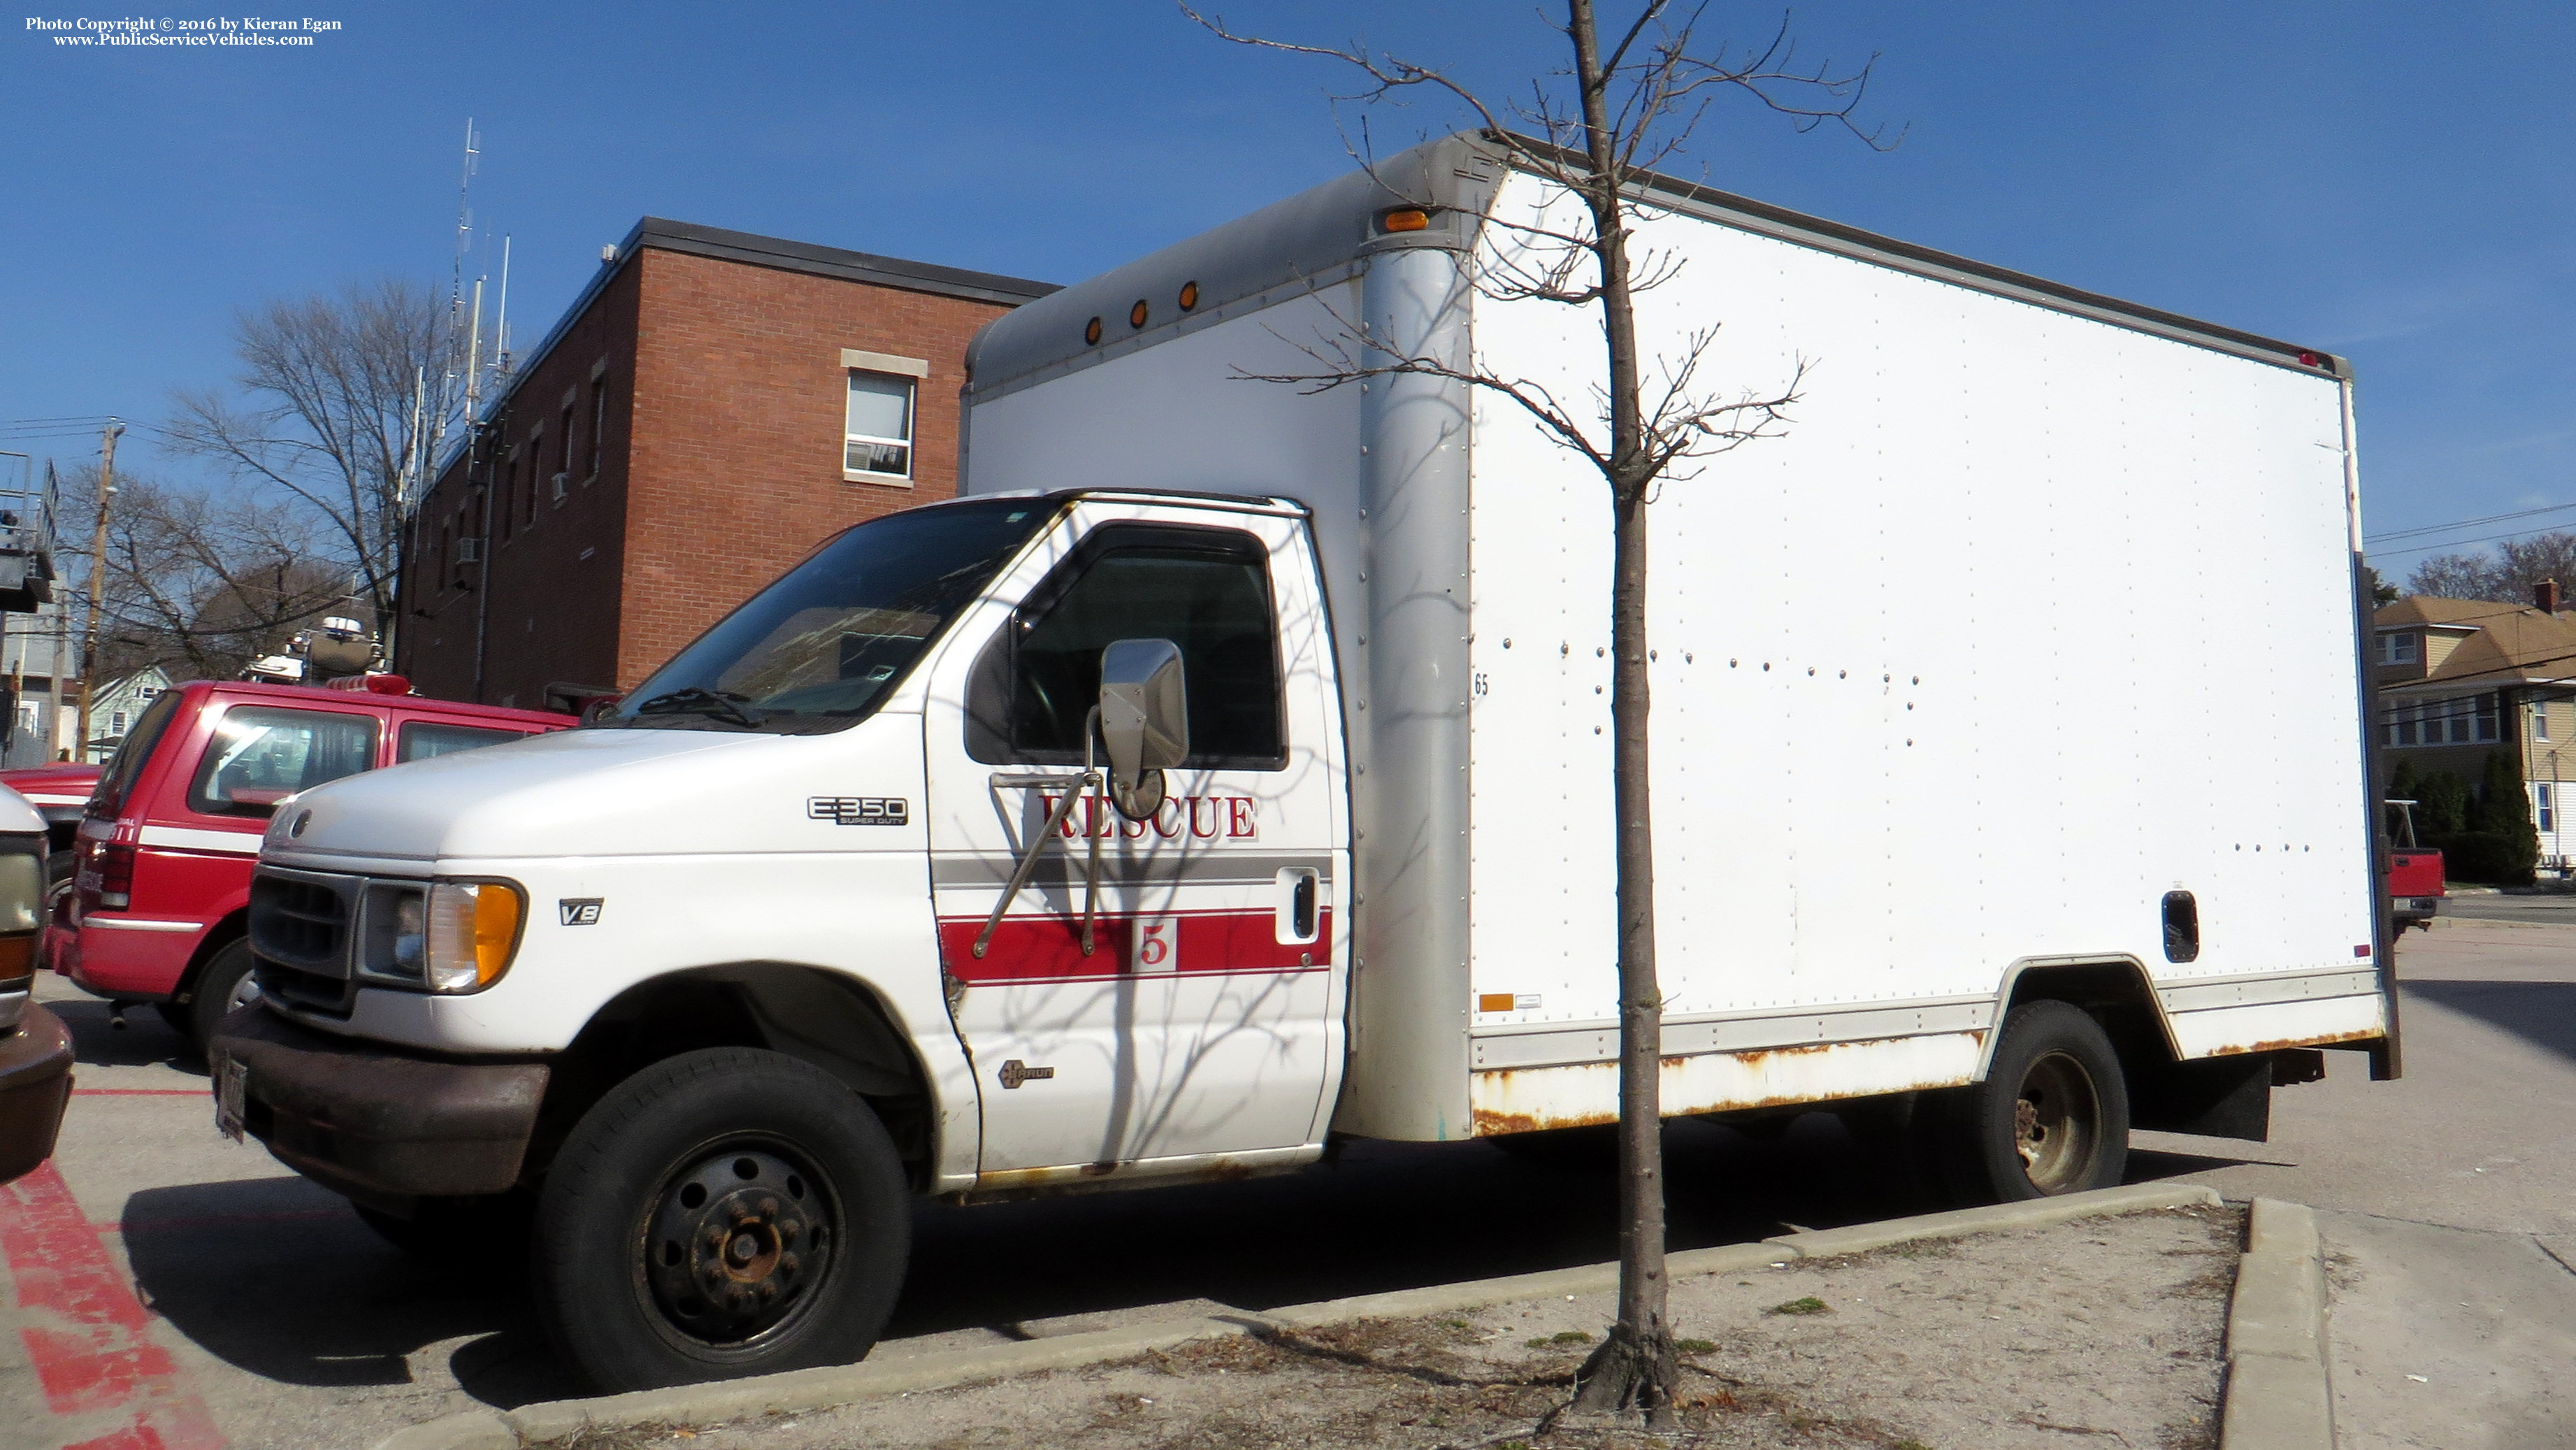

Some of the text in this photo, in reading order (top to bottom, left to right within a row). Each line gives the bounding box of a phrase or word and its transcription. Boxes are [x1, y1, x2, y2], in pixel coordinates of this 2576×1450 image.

[1475, 673, 1488, 696] 65
[561, 905, 600, 924] V8
[1141, 924, 1167, 965] 5
